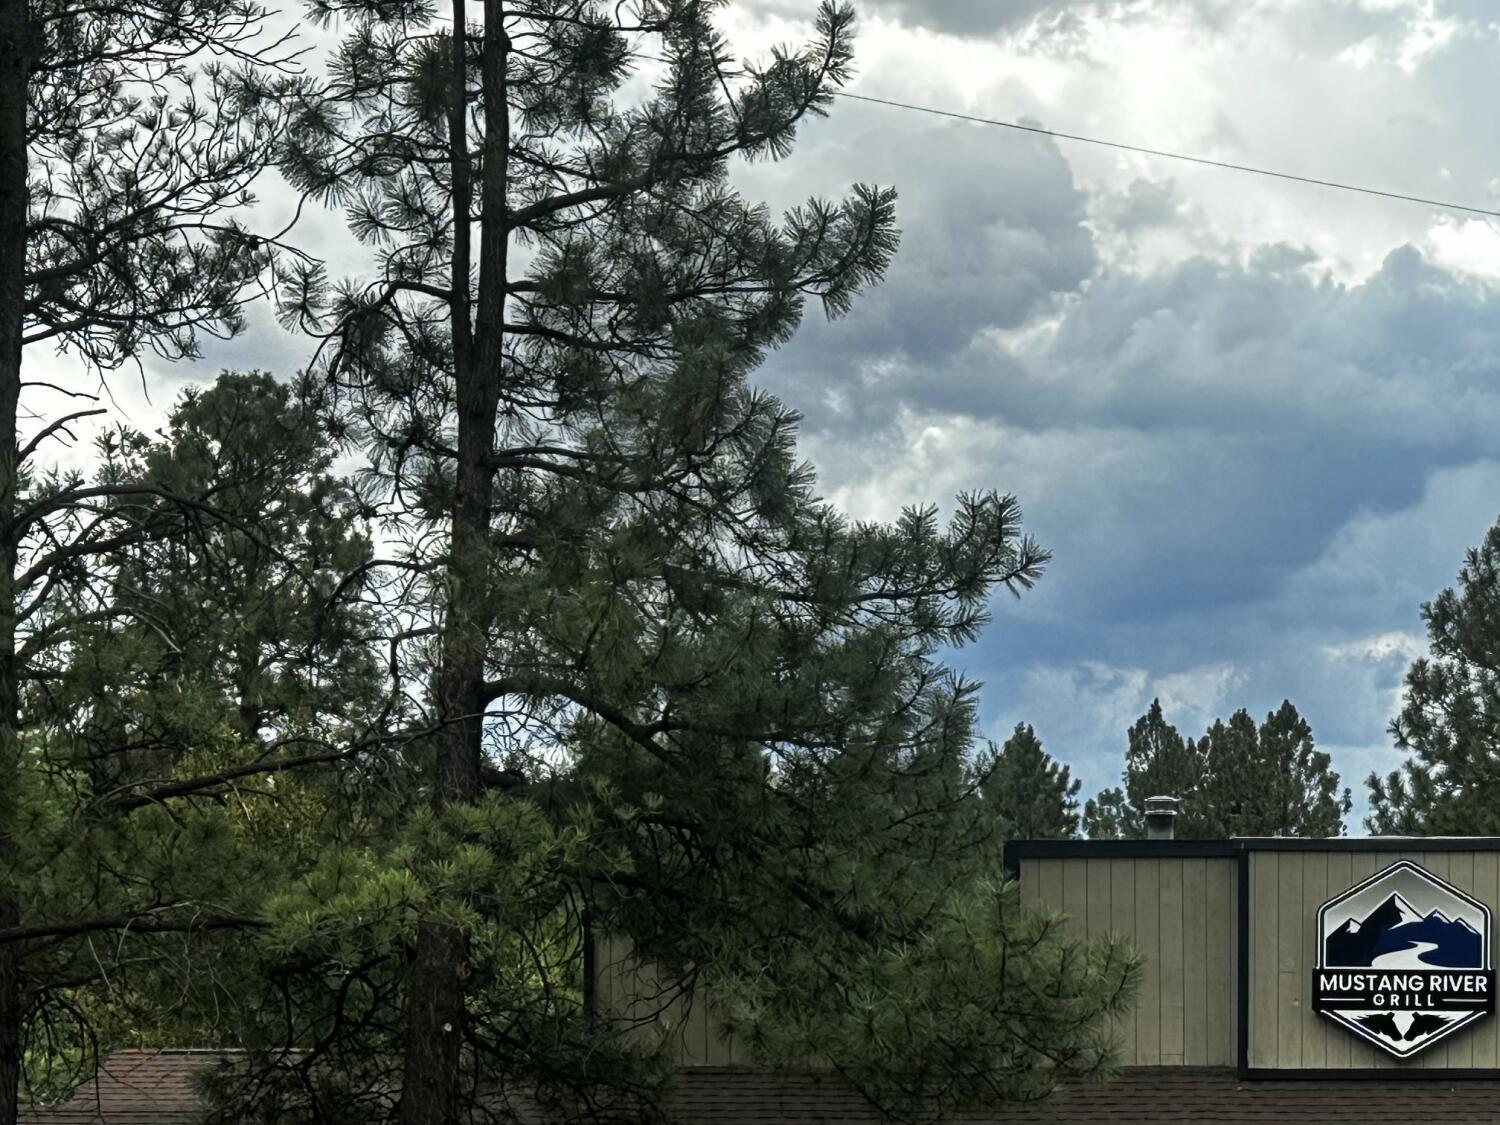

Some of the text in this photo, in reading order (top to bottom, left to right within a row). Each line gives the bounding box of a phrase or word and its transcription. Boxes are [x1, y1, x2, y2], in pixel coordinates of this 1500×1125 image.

[1320, 974, 1487, 992] MUSTANG RIVER
[1373, 994, 1435, 1007] GRILL
